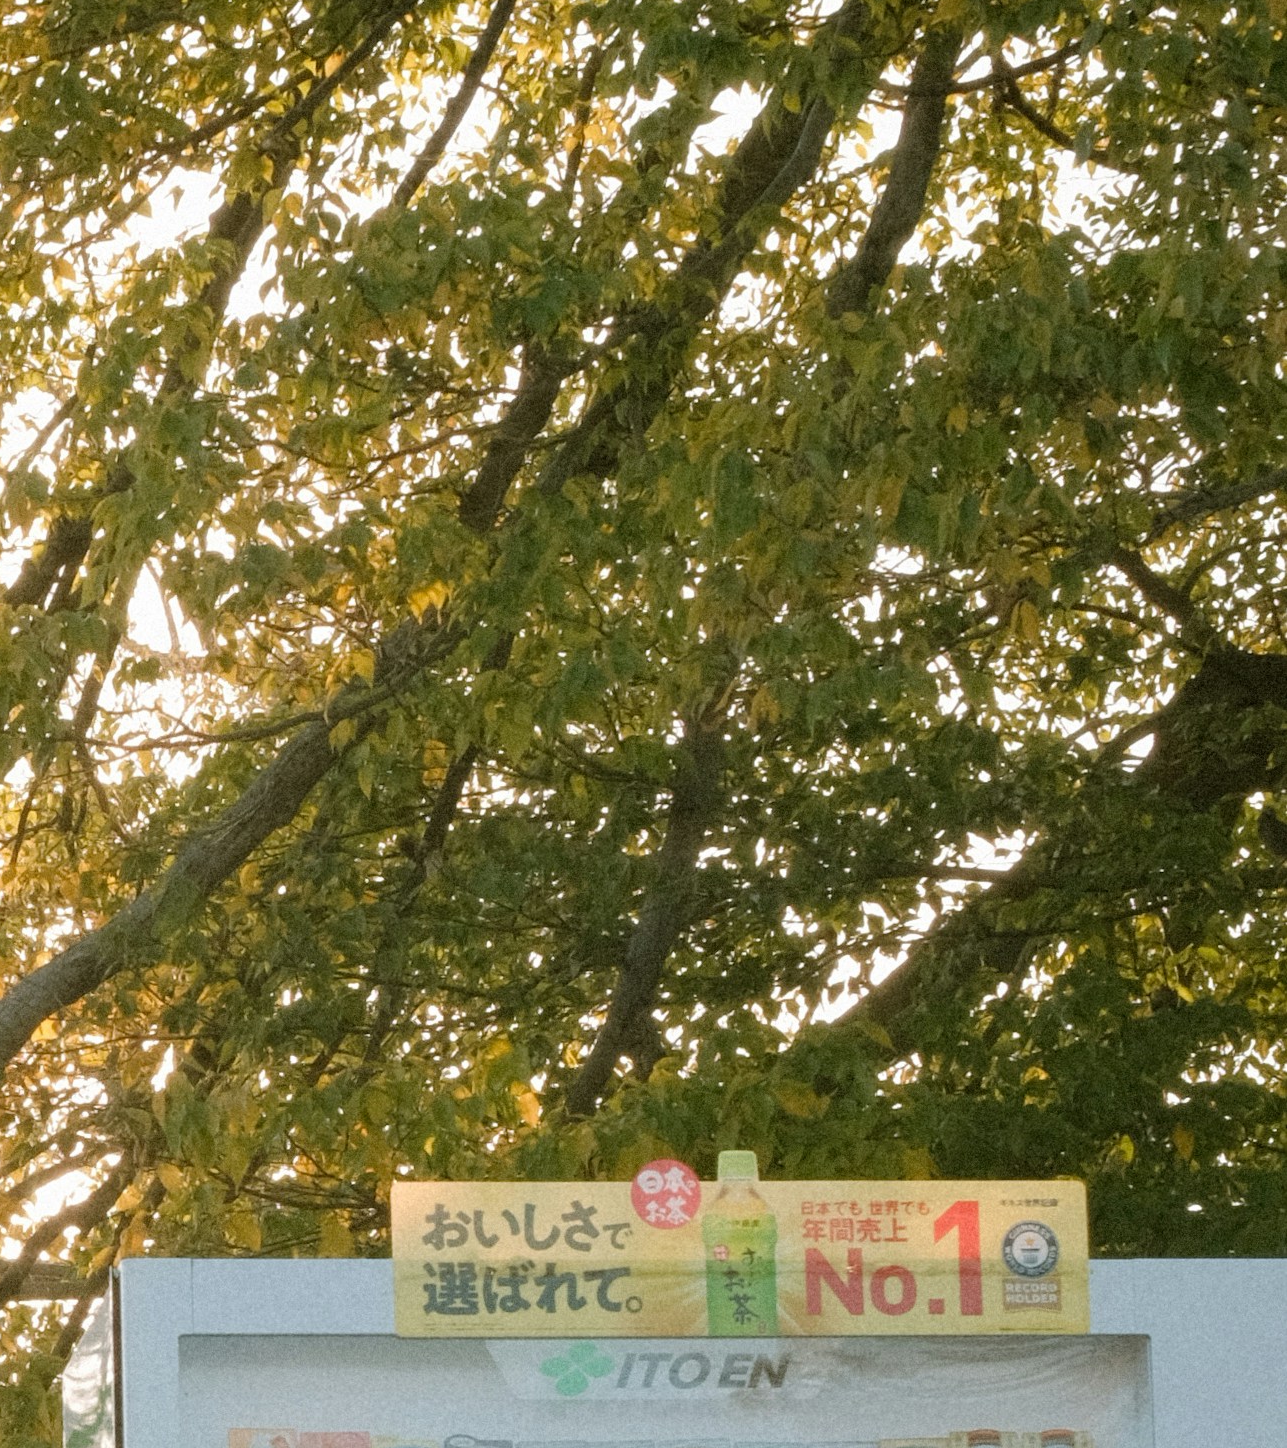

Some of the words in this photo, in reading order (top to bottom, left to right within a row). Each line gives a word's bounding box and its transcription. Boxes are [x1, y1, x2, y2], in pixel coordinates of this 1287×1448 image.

[801, 1201, 862, 1216] 日本でも
[869, 1201, 931, 1216] 世界でも
[422, 1200, 633, 1252] おいしさで
[802, 1218, 909, 1243] 年間売上
[805, 1200, 983, 1316] No.1
[423, 1260, 643, 1315] 選ばれて。
[1005, 1282, 1058, 1293] RECORD
[1005, 1293, 1059, 1304] HOLDER
[616, 1352, 711, 1389] ITO
[718, 1352, 791, 1389] EN
